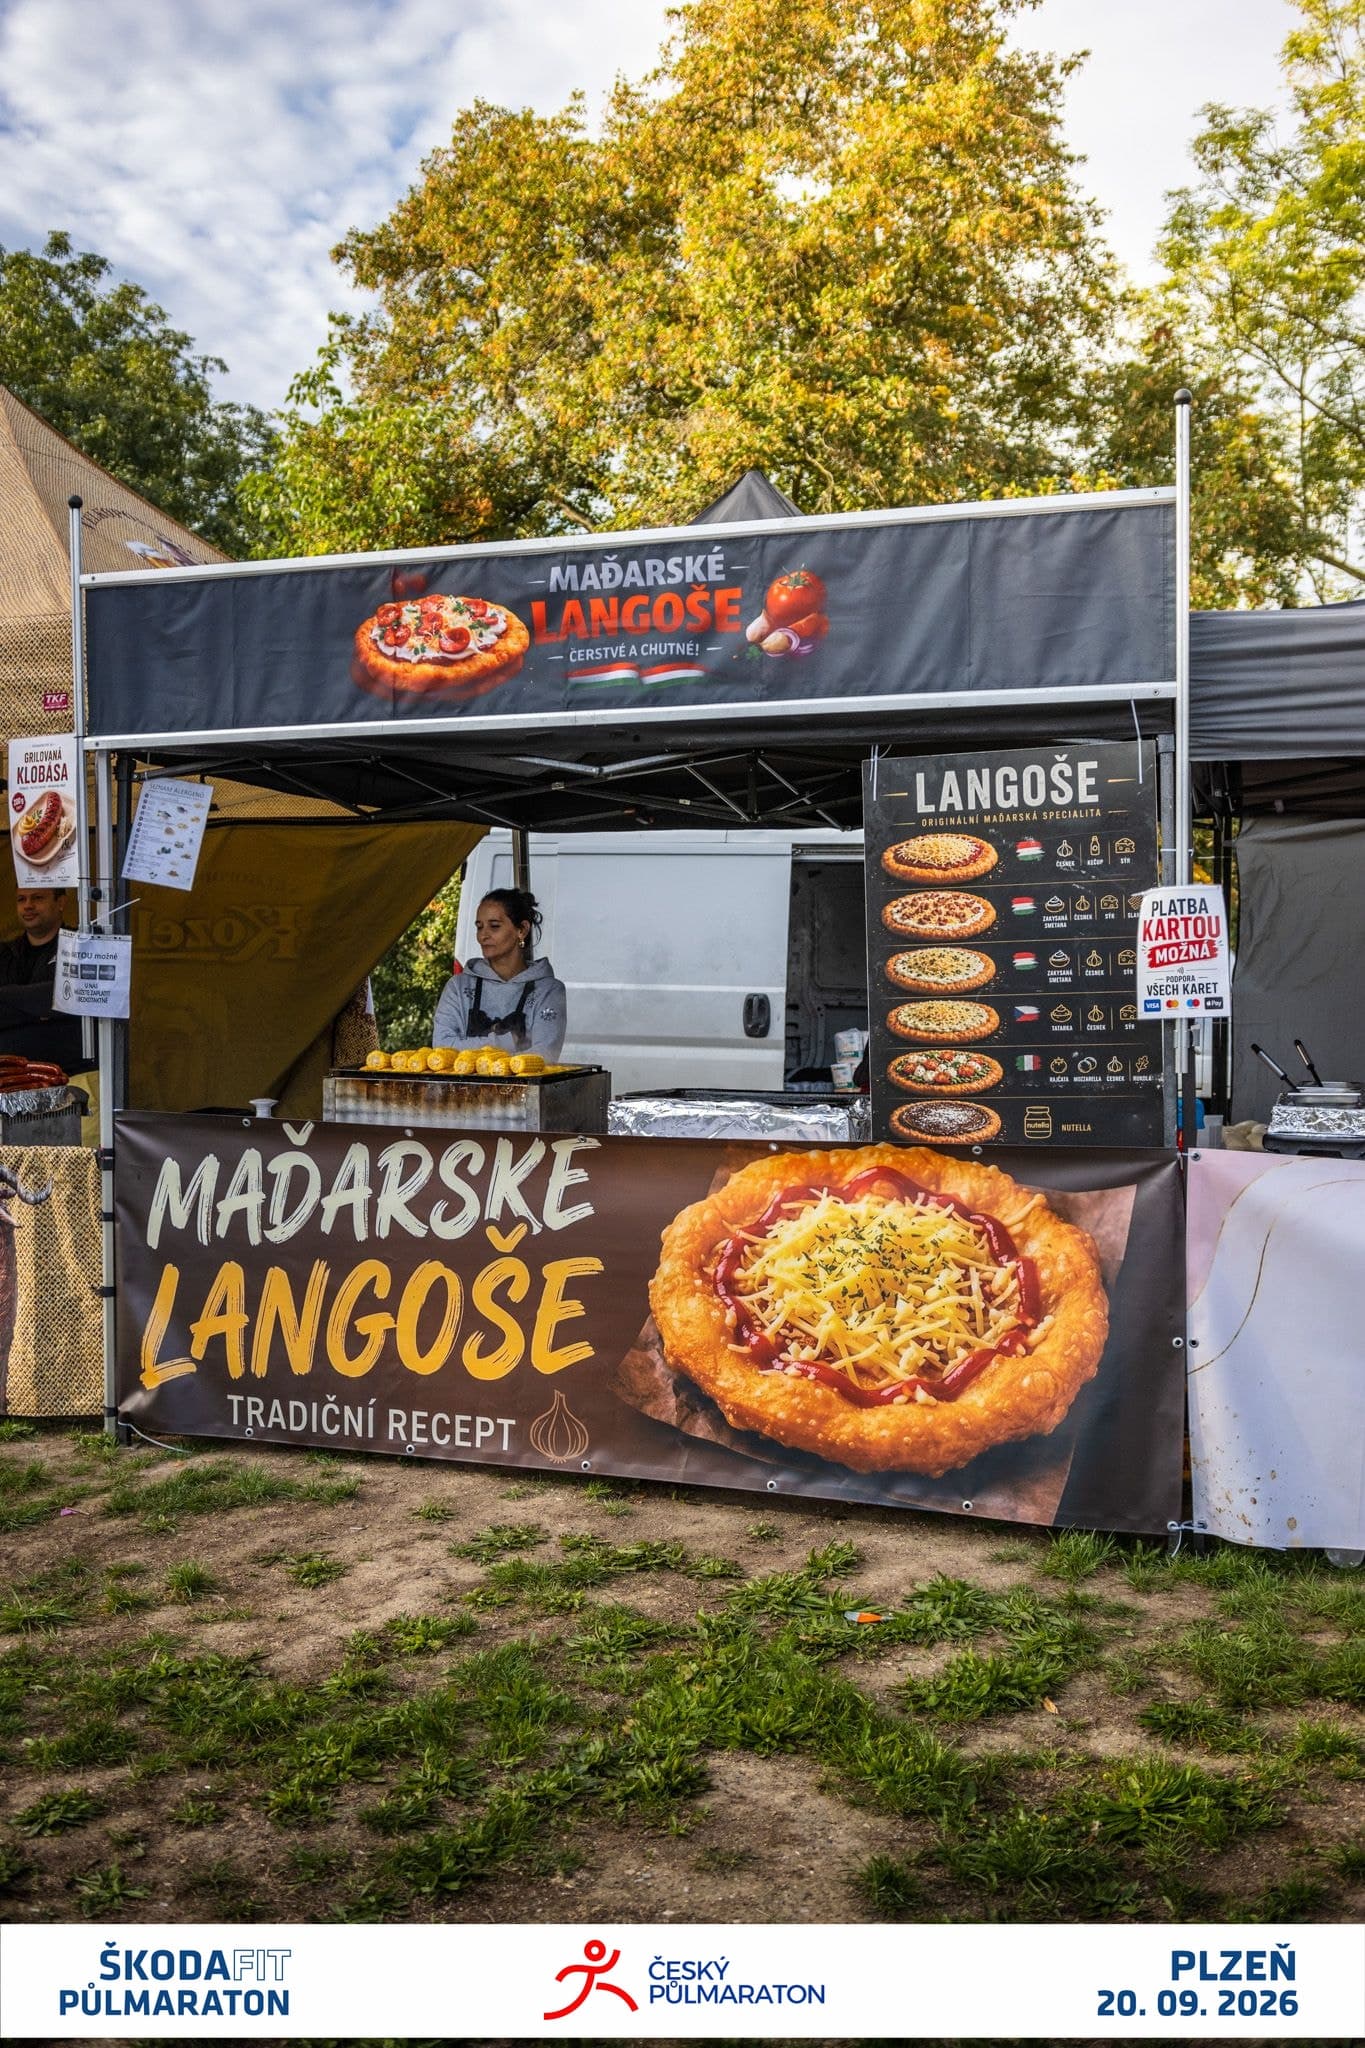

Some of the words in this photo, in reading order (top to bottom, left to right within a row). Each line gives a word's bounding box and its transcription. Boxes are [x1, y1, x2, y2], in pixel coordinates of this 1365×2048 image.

[550, 546, 726, 592] MAĎARSKÉ
[531, 584, 743, 645] LANGOŠE
[569, 643, 626, 662] ČERSTVÉ
[629, 645, 638, 656] A
[640, 640, 699, 657] CHUTNÉ!
[45, 694, 67, 704] TKF
[24, 746, 62, 763] GRILOVANÁ
[17, 762, 68, 784] KLOBÁSA
[916, 754, 1099, 813] LANGOŠE
[921, 814, 979, 827] ORIGINÁLNÍ
[983, 811, 1038, 824] MAĎARSKÁ
[1042, 808, 1101, 820] SPECIALITA
[1055, 859, 1075, 867] ČESNEK
[1087, 858, 1103, 866] KEČUP
[1073, 912, 1092, 920] ČESNEK
[1151, 898, 1209, 917] PLATBA
[1142, 916, 1221, 942] KARTOU
[1155, 941, 1211, 964] MOŽNÁ
[1166, 974, 1196, 983] PODPORA
[1146, 982, 1179, 996] VŠECH
[1182, 982, 1218, 995] KARET
[1086, 1023, 1106, 1031] ČESNEK
[1061, 1123, 1092, 1132] NUTELLA
[140, 1222, 604, 1390] LANGOŠE
[227, 1394, 376, 1438] TRADIČNÍ
[388, 1408, 516, 1450] RECEPT
